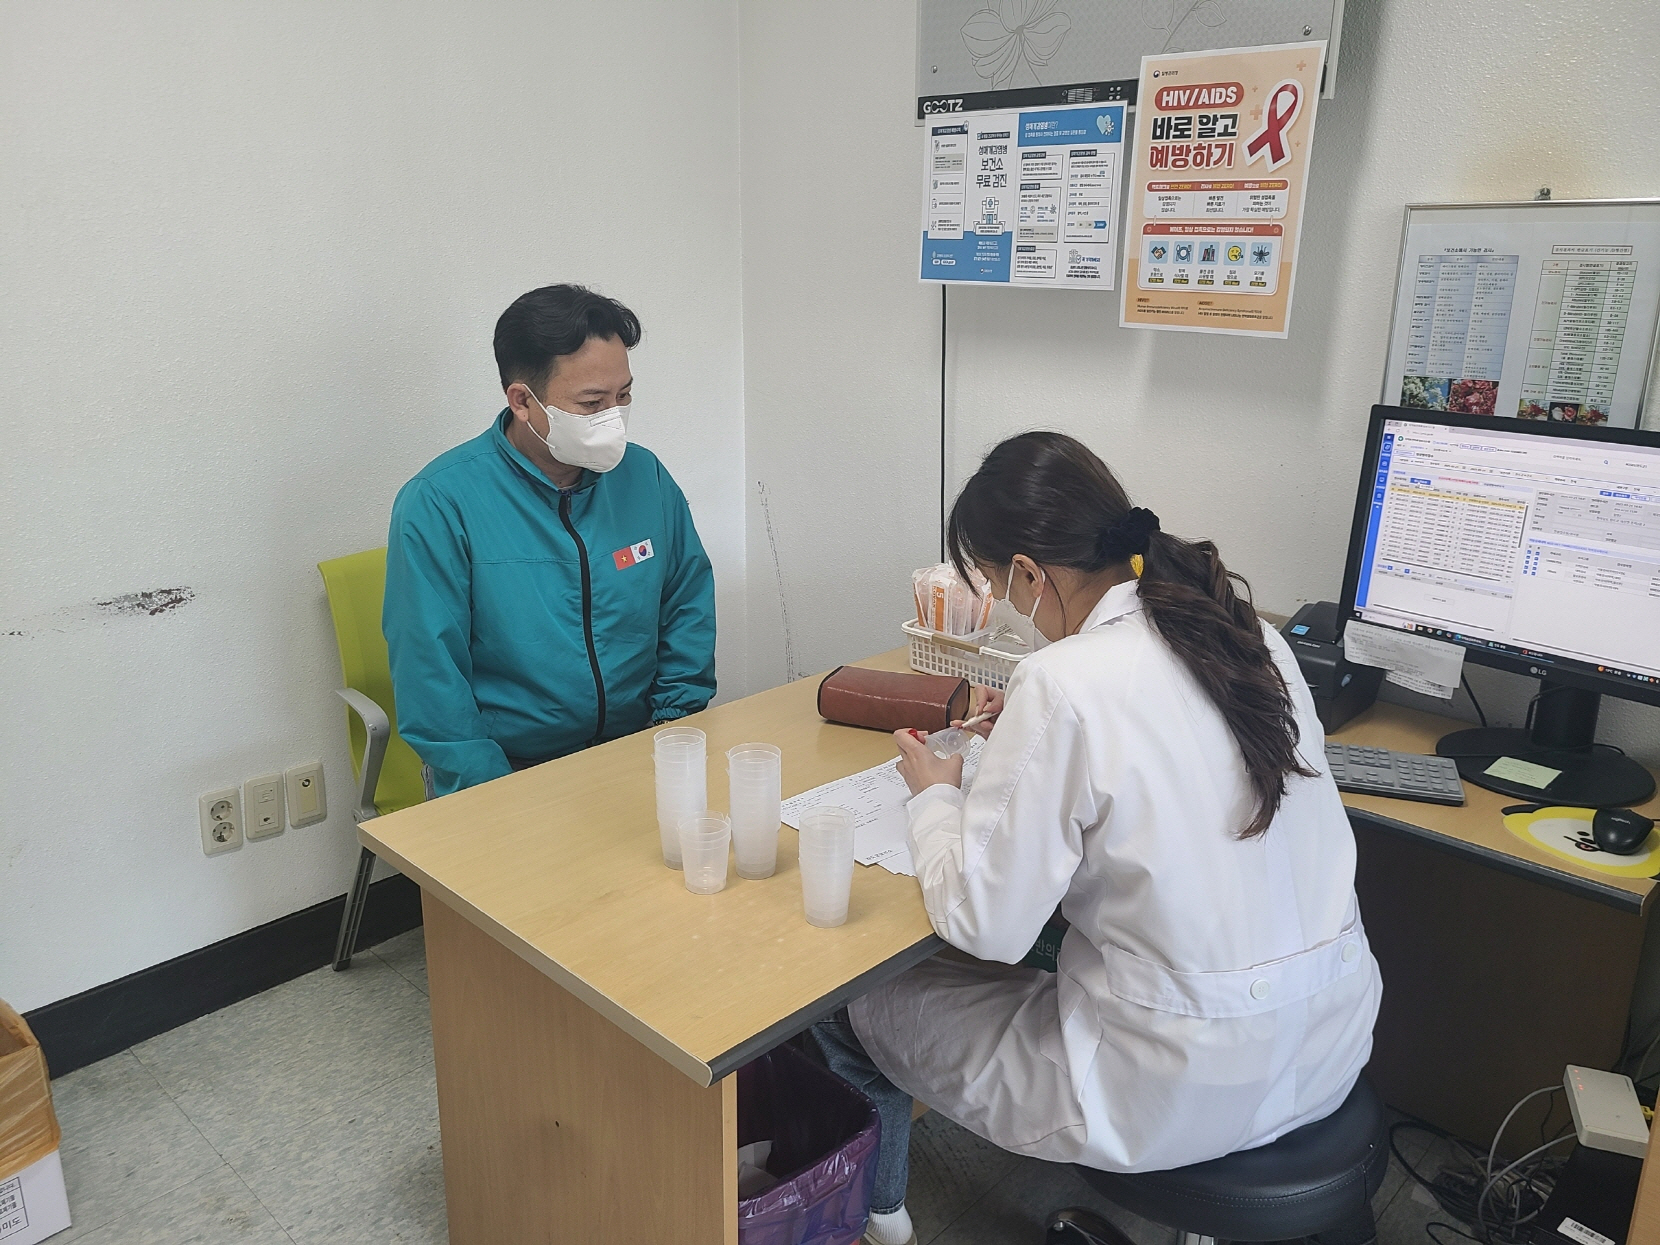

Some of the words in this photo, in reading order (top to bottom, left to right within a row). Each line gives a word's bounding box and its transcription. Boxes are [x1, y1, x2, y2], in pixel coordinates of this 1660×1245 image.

[1161, 86, 1238, 107] HIV/AIDS
[1152, 116, 1193, 140] 바로
[1197, 114, 1239, 138] 알고
[978, 145, 1008, 155] 성매개감염병
[1150, 142, 1235, 169] 예방하기
[981, 157, 1004, 172] 보건소
[976, 174, 991, 188] 무료
[992, 173, 1007, 188] 검진
[0, 1216, 22, 1234] 미도
